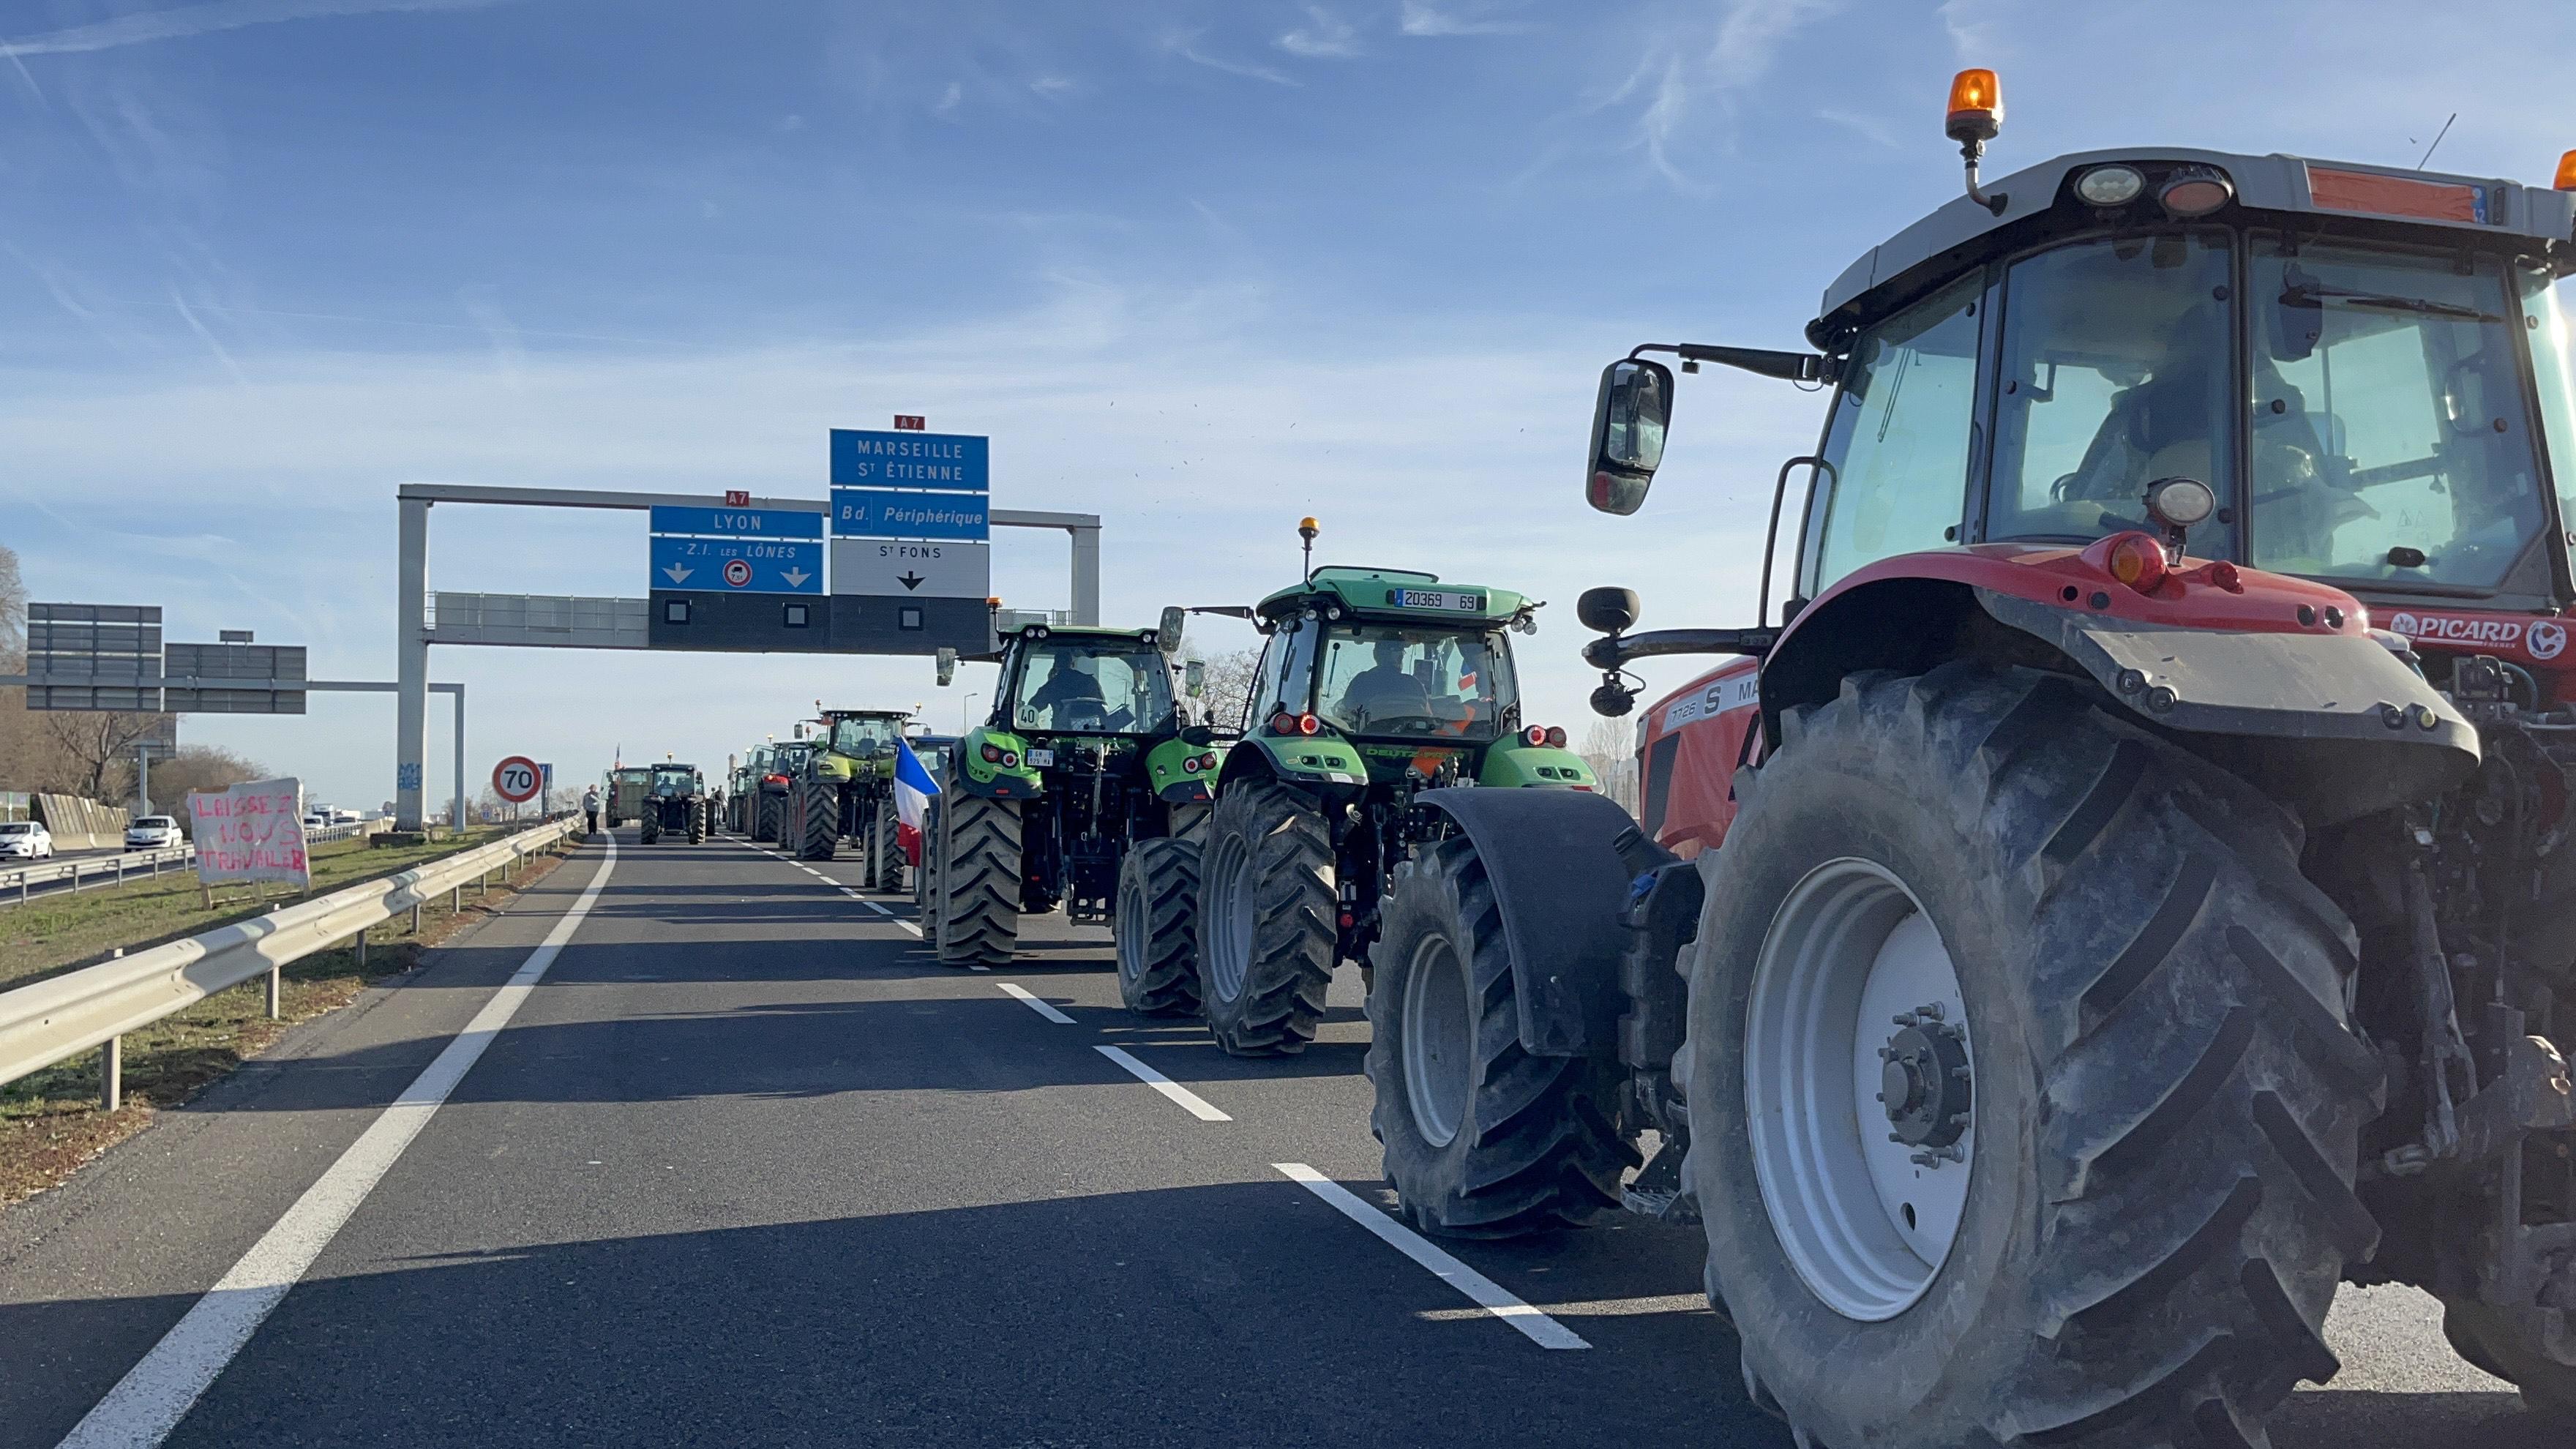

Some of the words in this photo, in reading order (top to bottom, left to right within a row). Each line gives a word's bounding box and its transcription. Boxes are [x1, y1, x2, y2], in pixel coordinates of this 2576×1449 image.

[857, 440, 963, 459] MARSEILLE
[728, 492, 746, 505] A7
[714, 514, 762, 531] LYON
[842, 505, 869, 521] Bd.
[884, 506, 983, 526] Périphérique
[720, 547, 737, 557] LES
[746, 544, 796, 559] LÔNES
[899, 547, 942, 559] FONS
[1405, 592, 1442, 607] 20369
[1459, 596, 1475, 609] 69
[2419, 617, 2522, 642] PICARD
[1671, 702, 1697, 722] 7726
[1704, 686, 1721, 714] S
[1021, 709, 1035, 723] 40
[504, 770, 532, 789] 70
[196, 795, 293, 817] LAISSEZ
[218, 821, 301, 845] NOUS
